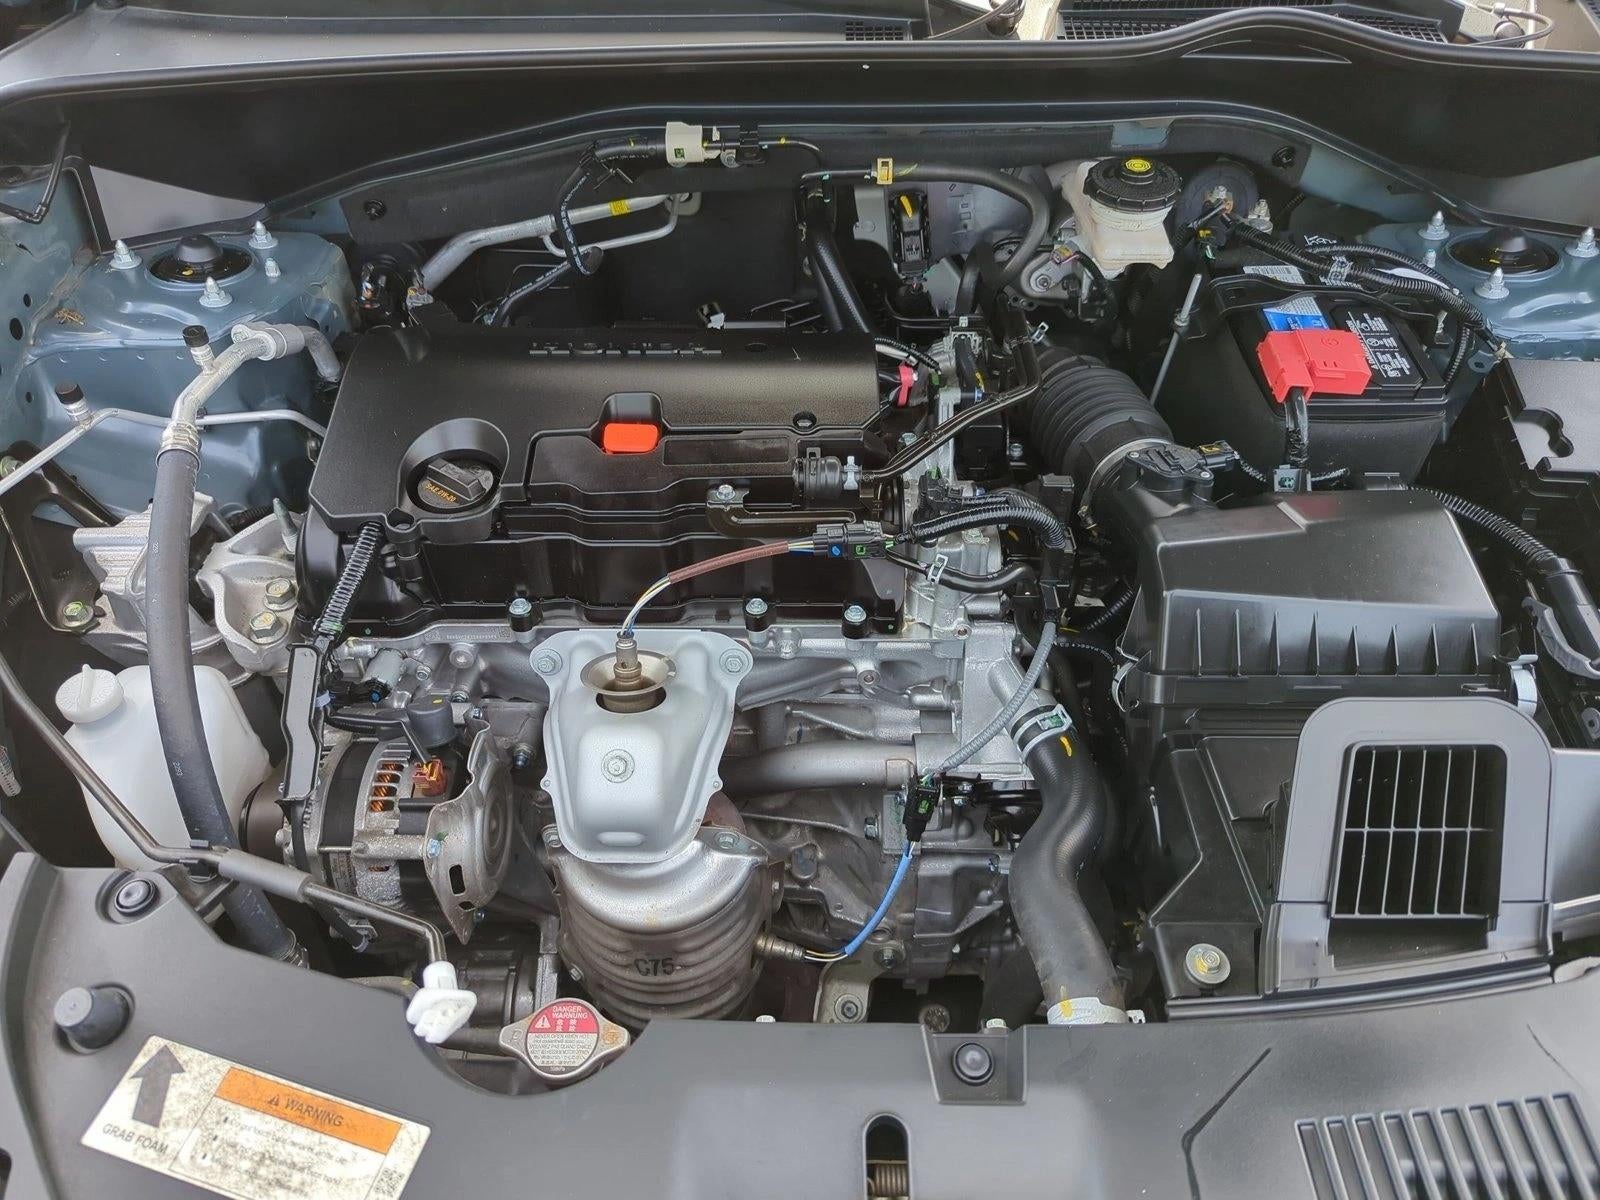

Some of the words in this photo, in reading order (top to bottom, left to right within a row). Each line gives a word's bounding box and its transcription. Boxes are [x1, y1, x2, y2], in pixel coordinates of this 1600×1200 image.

[285, 1098, 344, 1127] WARNING
[102, 1123, 135, 1142] GRAB
[135, 1136, 169, 1155] FOAM
